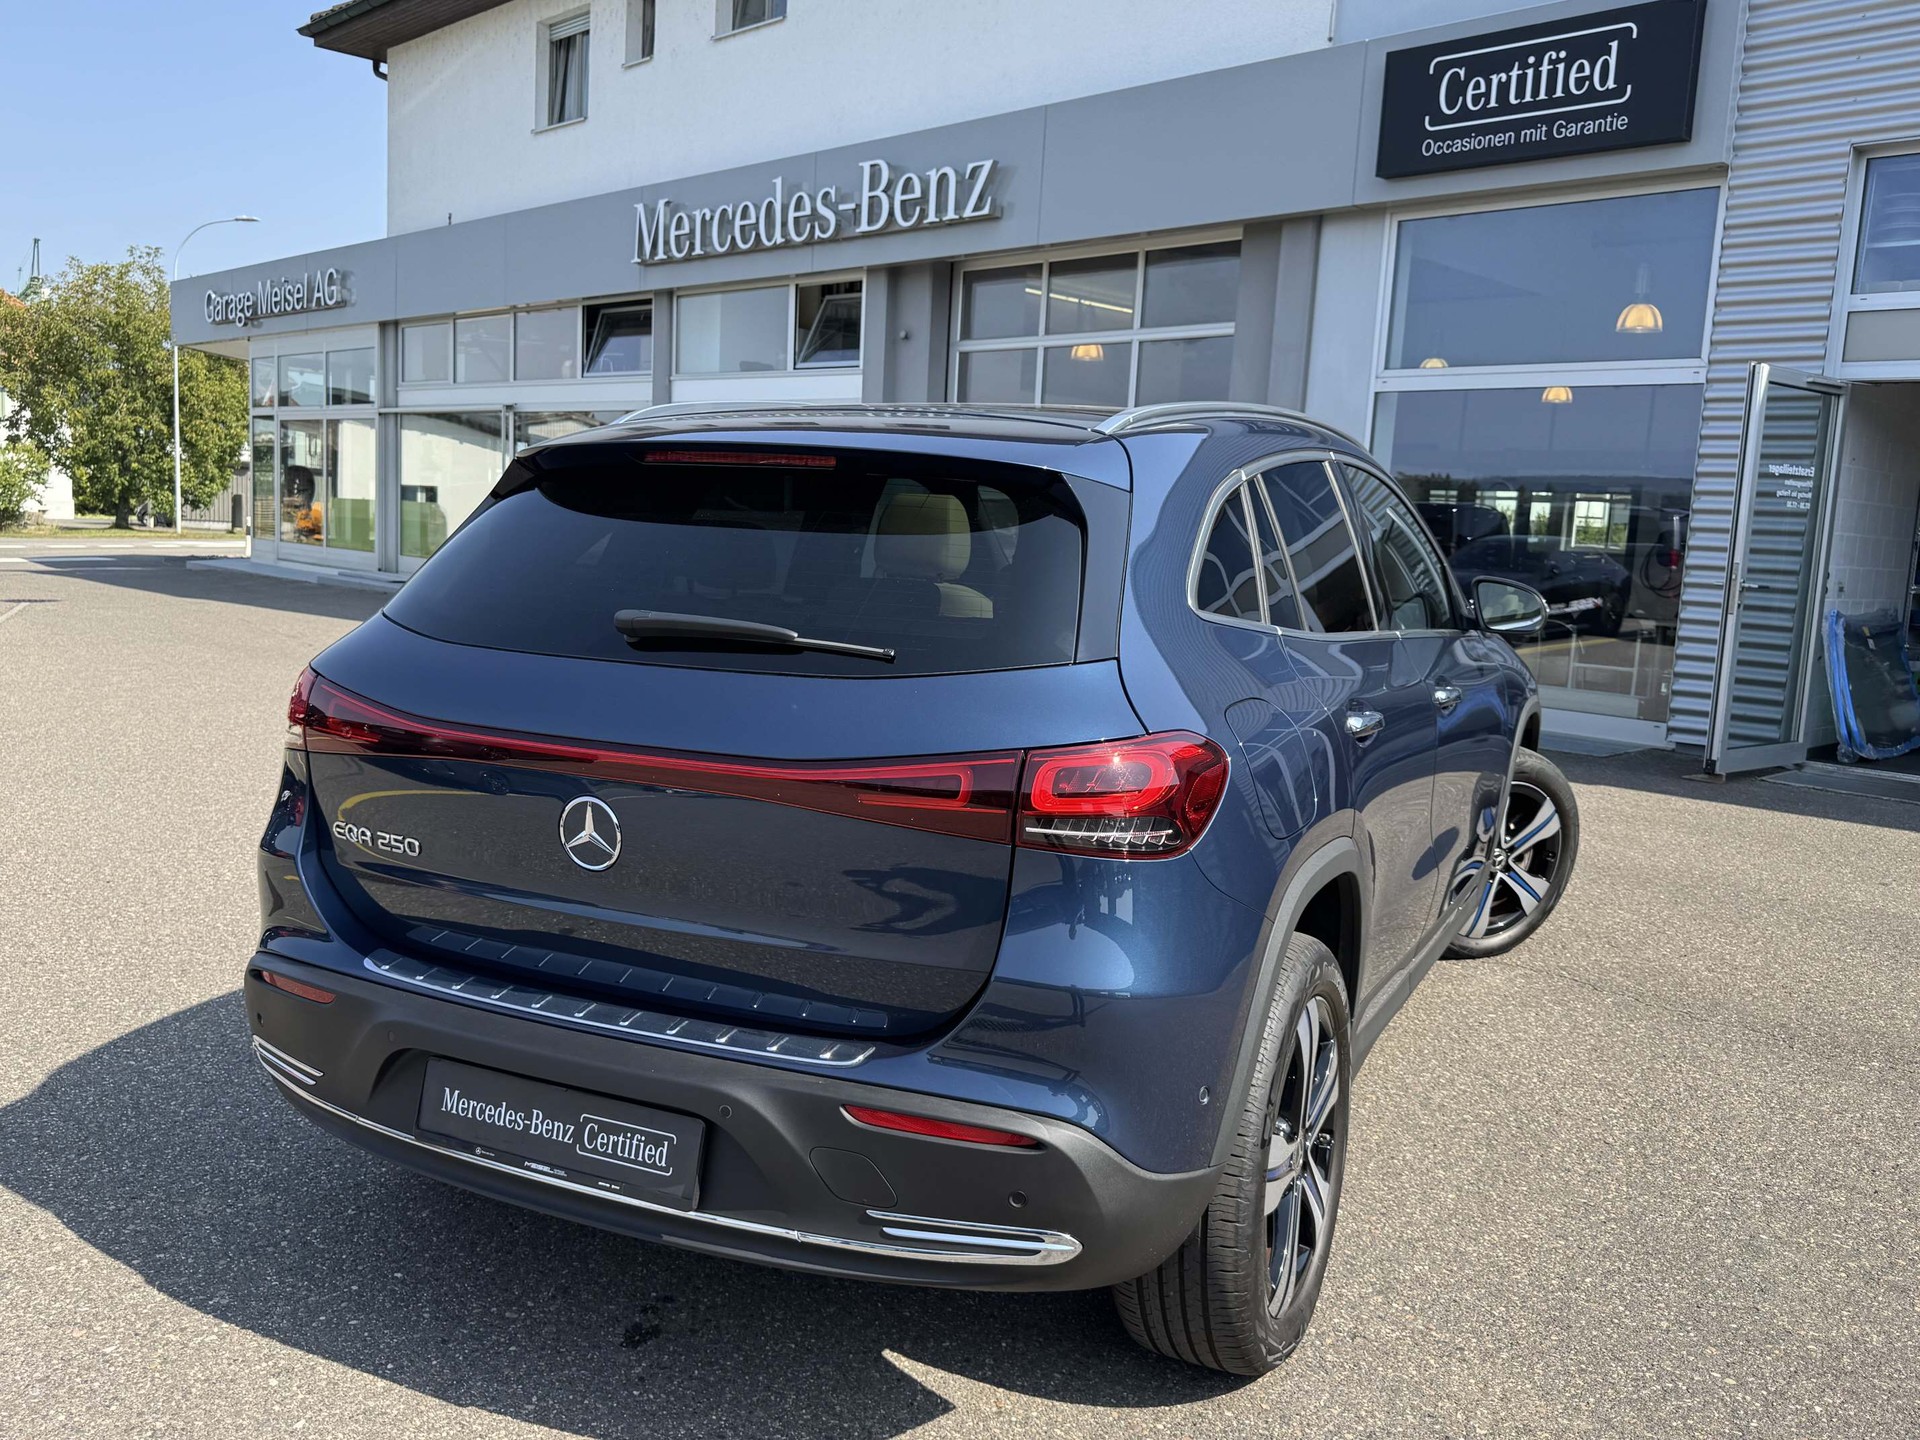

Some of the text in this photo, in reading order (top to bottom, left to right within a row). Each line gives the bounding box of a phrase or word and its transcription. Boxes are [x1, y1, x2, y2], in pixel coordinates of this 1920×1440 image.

[1439, 40, 1618, 116] Certified
[1421, 112, 1629, 157] Occasionen mit Garantie
[631, 158, 996, 264] Mercedes-Benz
[204, 267, 337, 328] Garage Meisel AG
[333, 821, 420, 857] EQA 250
[441, 1087, 669, 1167] Mercedes-Benz Certified
